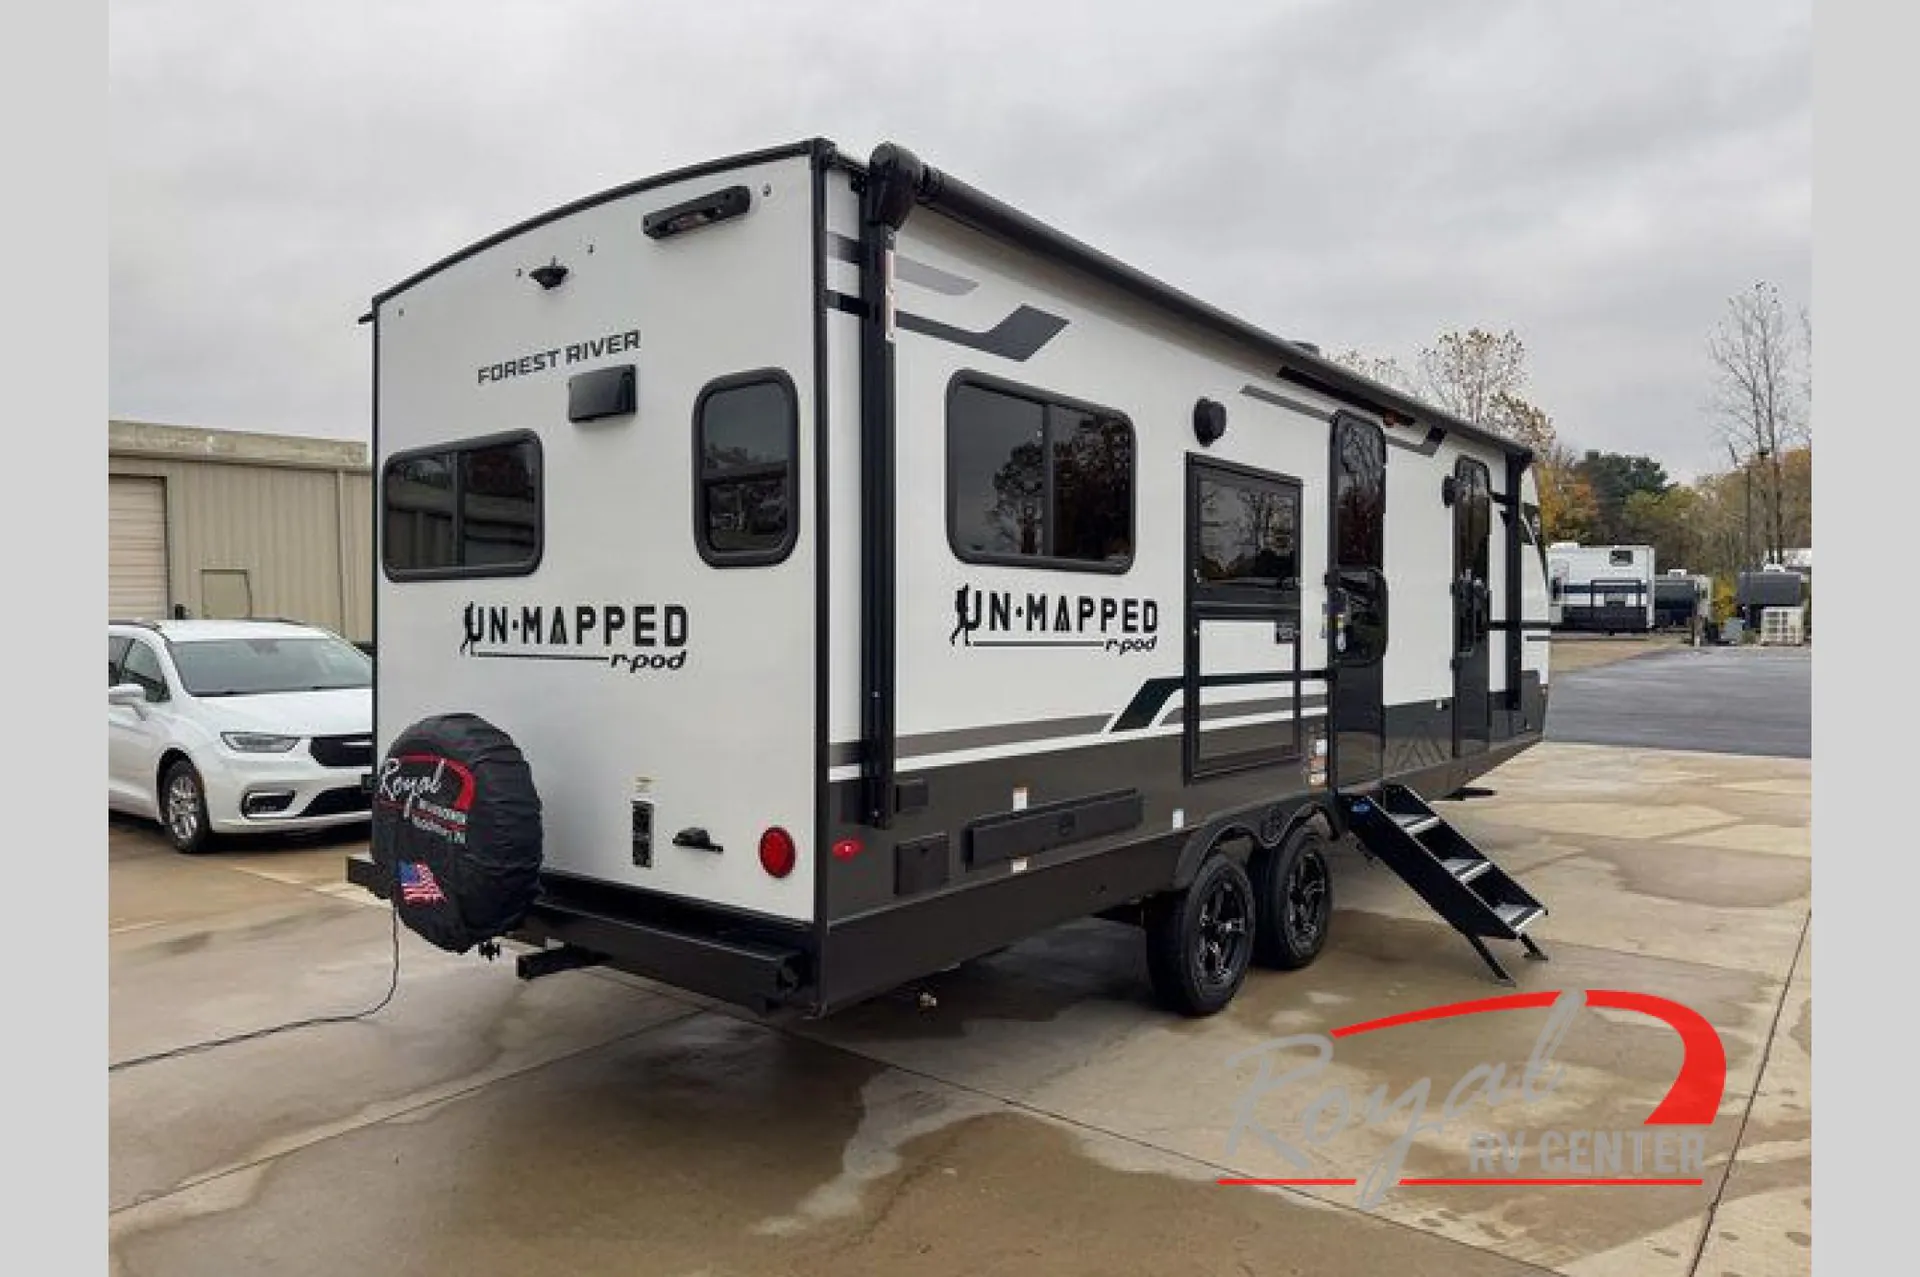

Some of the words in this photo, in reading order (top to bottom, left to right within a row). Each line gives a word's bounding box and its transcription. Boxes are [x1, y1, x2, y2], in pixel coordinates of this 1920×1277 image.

[477, 348, 562, 384] FOREST
[565, 329, 641, 365] RIVER
[379, 757, 447, 820] Royal
